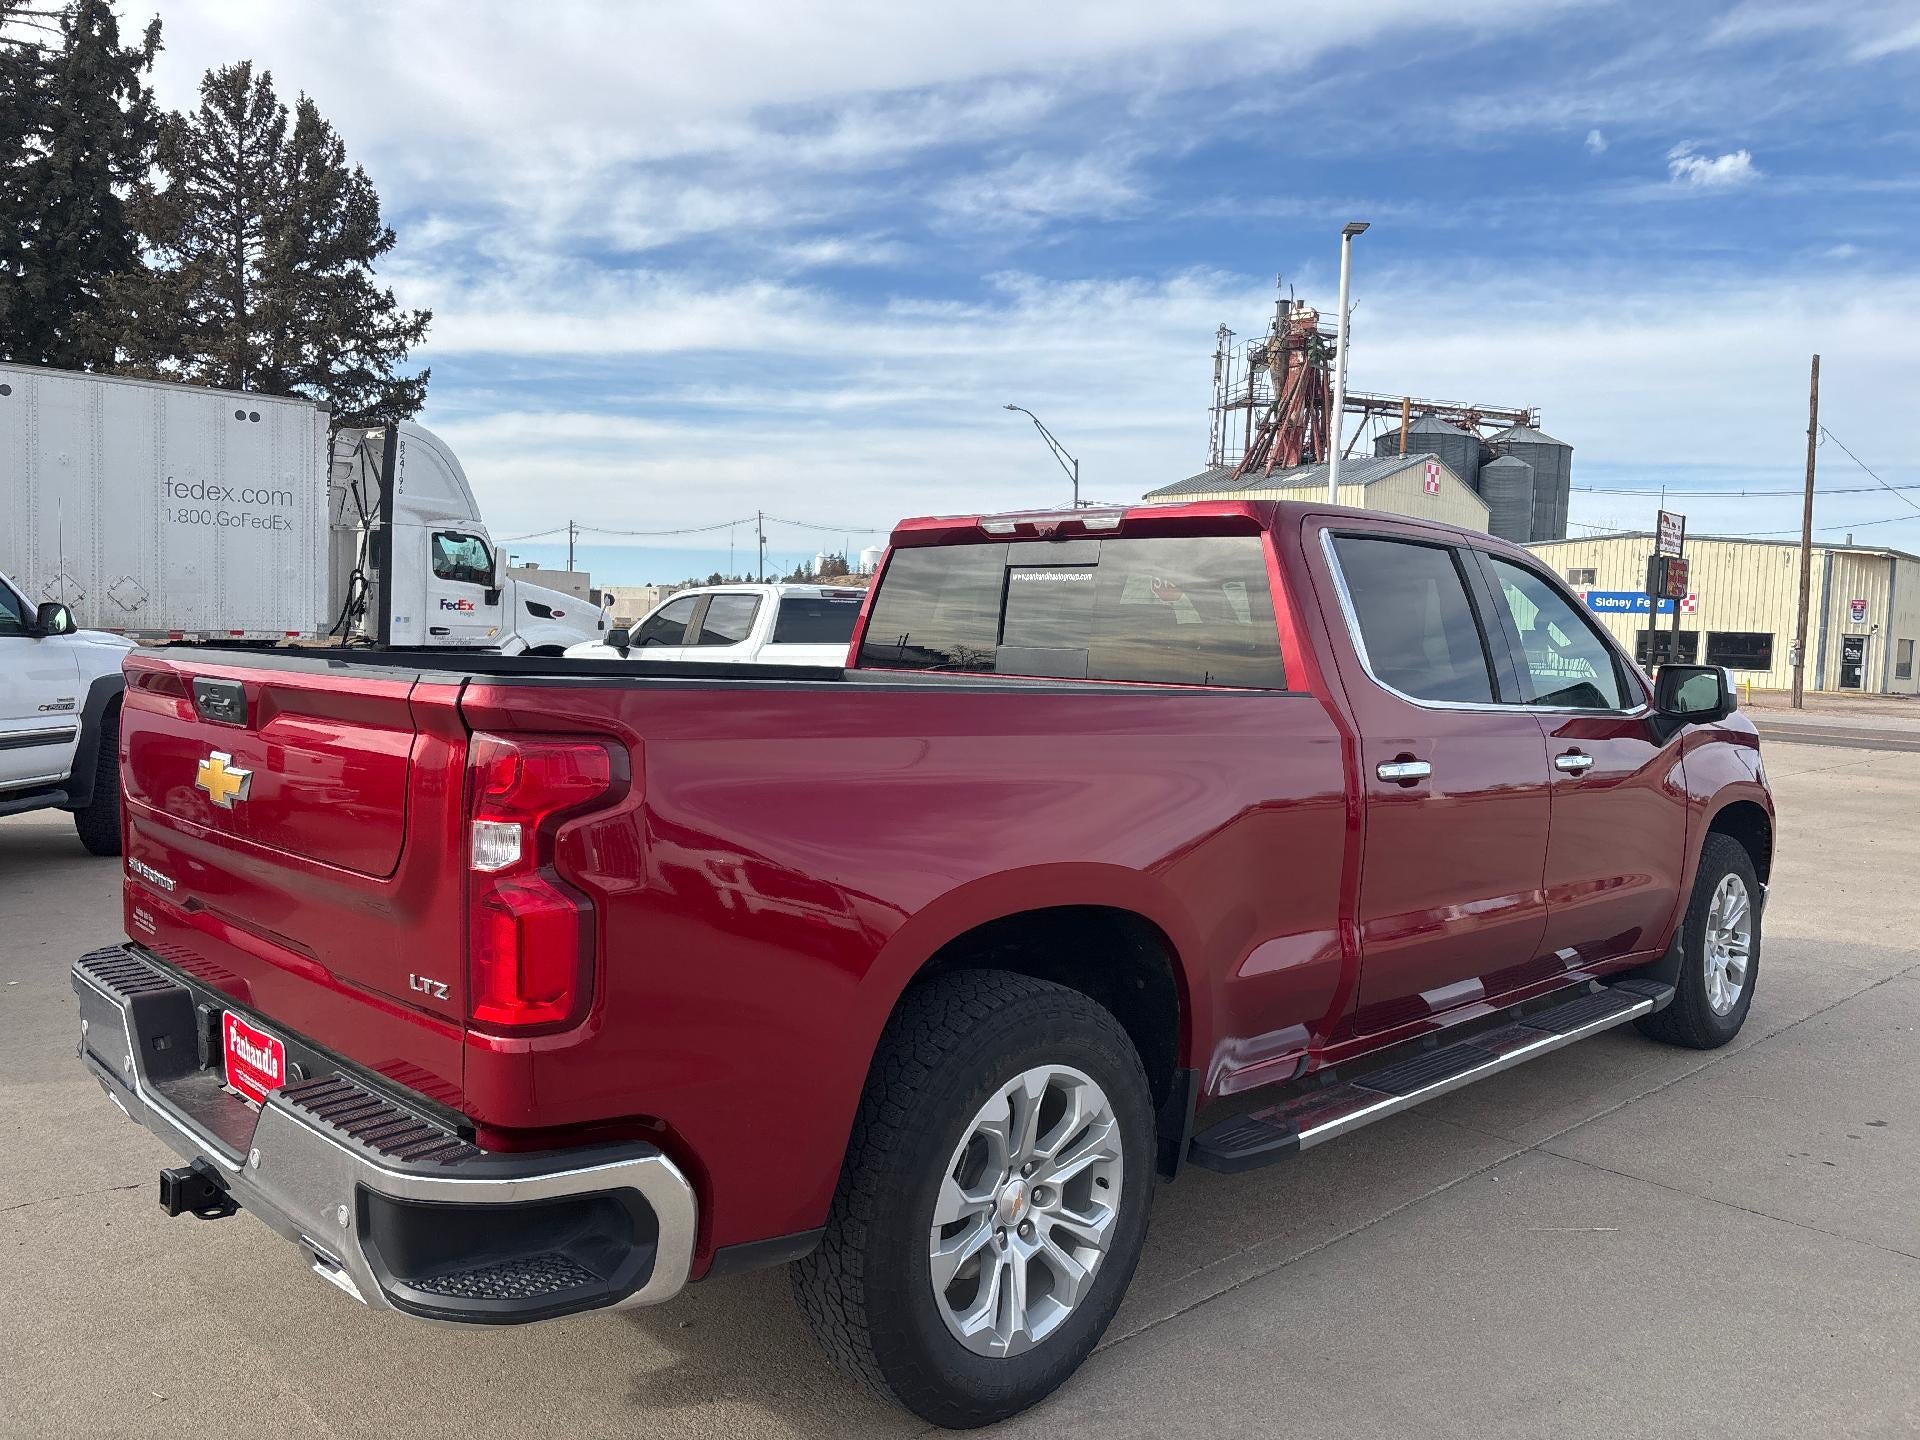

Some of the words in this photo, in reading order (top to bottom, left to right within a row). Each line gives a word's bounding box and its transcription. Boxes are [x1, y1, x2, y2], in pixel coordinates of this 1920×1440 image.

[164, 476, 293, 506] fedex.com
[165, 507, 293, 531] 1.800.GoFedEx
[439, 598, 475, 611] FedEx
[1595, 597, 1632, 610] Sidney
[1636, 597, 1666, 608] Fed
[409, 973, 450, 1000] LTZ
[229, 1025, 278, 1080] Panhandle
